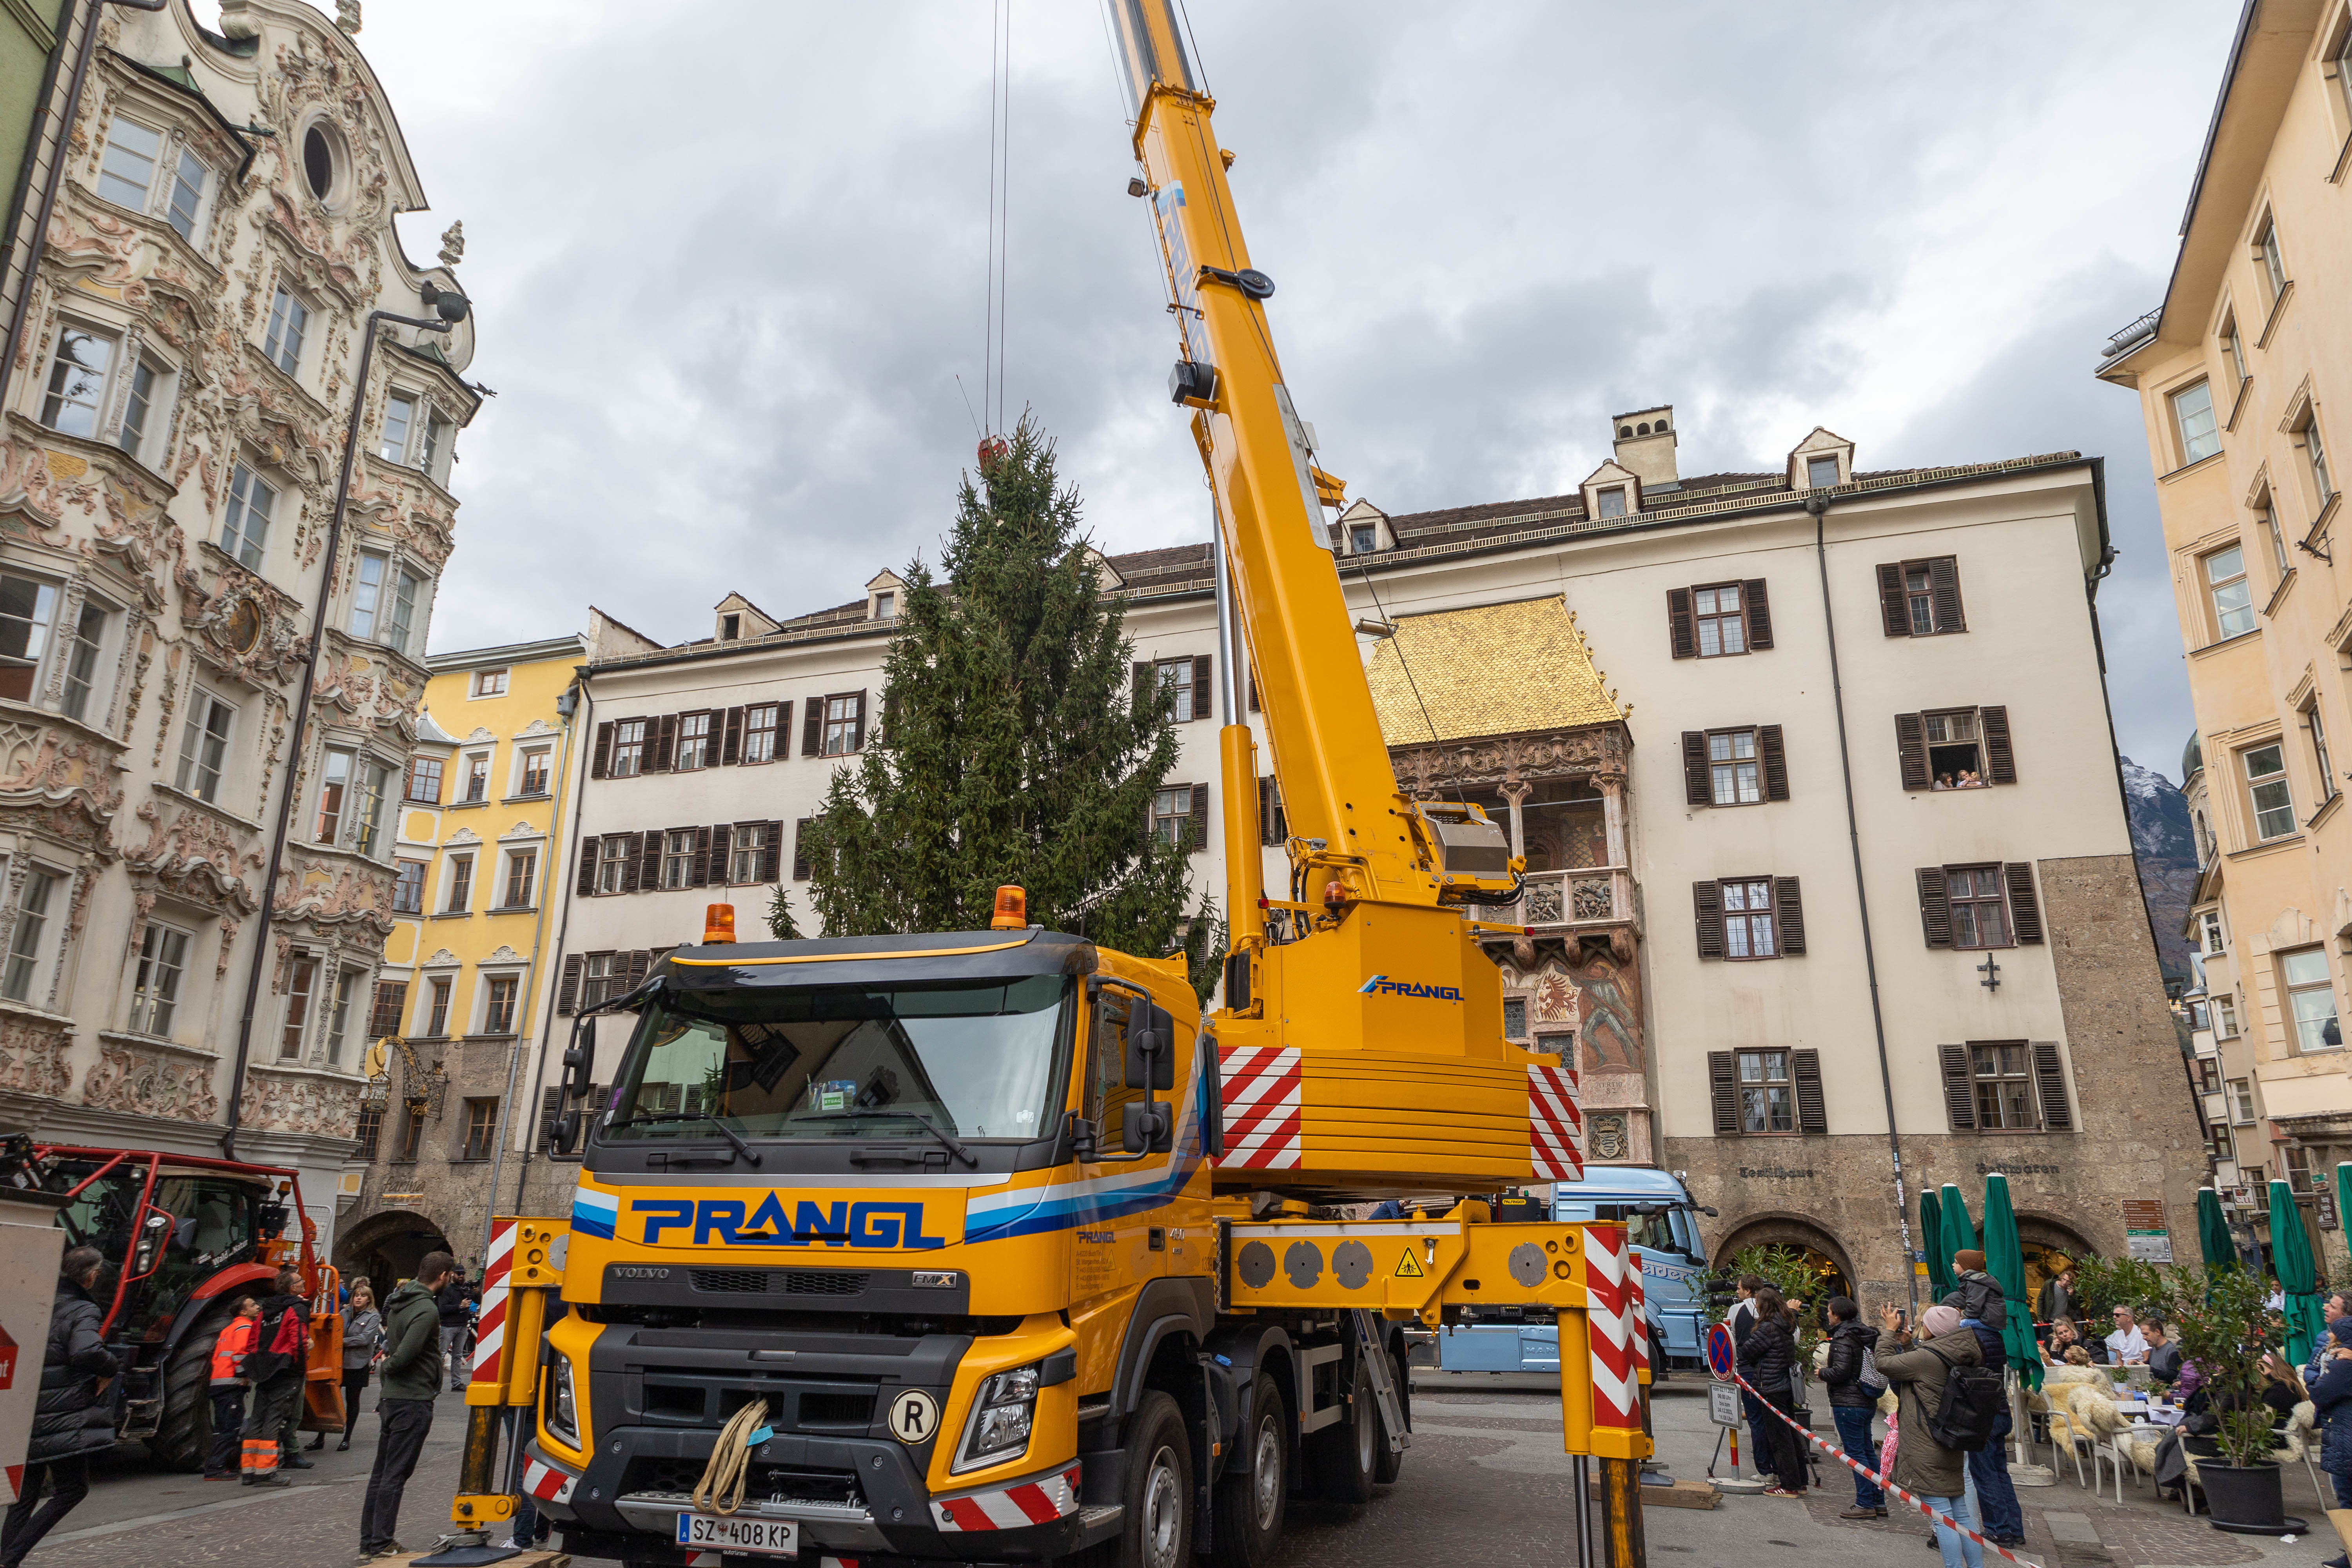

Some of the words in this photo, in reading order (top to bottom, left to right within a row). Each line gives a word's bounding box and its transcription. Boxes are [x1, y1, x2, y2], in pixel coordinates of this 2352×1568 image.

[1376, 981, 1465, 1001] PRANGL
[1739, 1166, 1813, 1180] Textilhaus
[1975, 1162, 2060, 1174] Bettwaren
[631, 1190, 946, 1250] PRANGL
[1076, 1229, 1117, 1243] PRANGL
[212, 1249, 229, 1265] Wald
[613, 1267, 669, 1279] VOLVO
[913, 1274, 953, 1286] FMX
[1713, 1368, 1730, 1379] ANFANG
[904, 1400, 924, 1434] R
[694, 1518, 715, 1541] SZ
[730, 1521, 763, 1545] 408
[769, 1524, 791, 1548] KP
